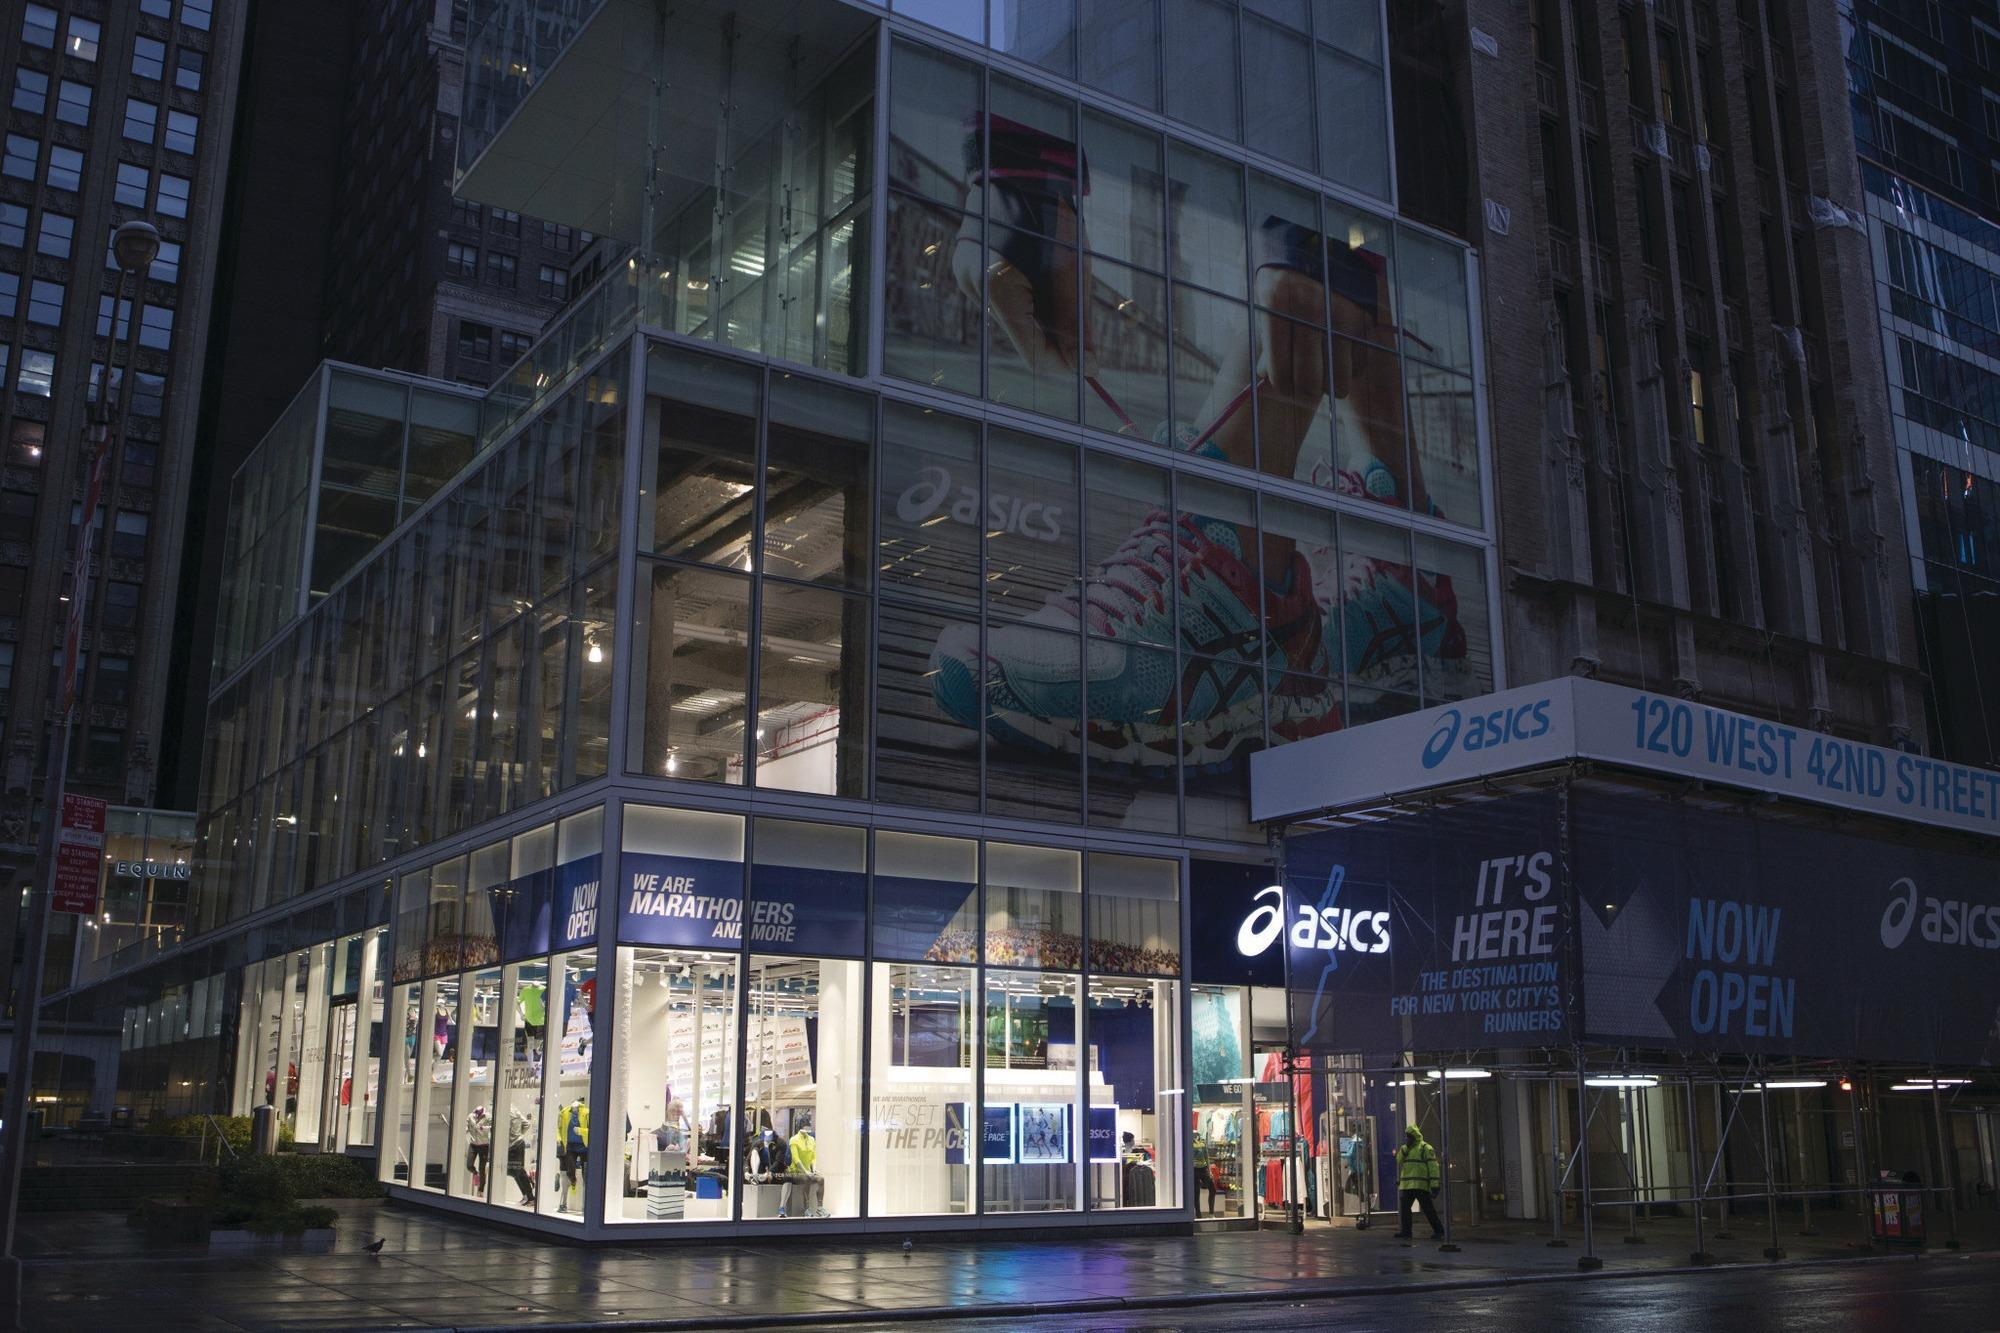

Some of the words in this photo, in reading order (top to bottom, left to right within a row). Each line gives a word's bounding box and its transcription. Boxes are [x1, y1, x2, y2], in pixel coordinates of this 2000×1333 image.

[951, 486, 1063, 542] asics
[1463, 699, 1550, 751] asics
[1632, 695, 1693, 758] 120
[1704, 709, 1797, 779] WEST
[1807, 737, 1886, 798] 42ND
[1896, 755, 2000, 821] STREET
[116, 862, 191, 879] EQUIN
[633, 873, 660, 892] WE
[661, 875, 696, 895] ARE
[1475, 851, 1553, 907] IT'S
[571, 880, 600, 913] NOW
[567, 908, 597, 941] OPEN
[711, 921, 743, 939] AND
[750, 924, 796, 943] MORE
[1291, 904, 1390, 954] asics
[1451, 905, 1558, 962] HERE
[1686, 897, 1782, 967] NOW
[1921, 896, 2000, 949] asics
[1420, 970, 1449, 992] THE
[1451, 961, 1558, 989] DESTINATION
[1391, 996, 1418, 1016] FOR
[1422, 993, 1456, 1014] NEW
[1460, 989, 1502, 1012] YORK
[1505, 985, 1559, 1009] CITY'S
[1690, 969, 1796, 1038] OPEN
[1484, 1009, 1562, 1033] RUNNERS
[1223, 1085, 1233, 1094] WE
[874, 1104, 901, 1126] WE
[905, 1104, 938, 1126] SET
[886, 1128, 917, 1149] THE
[923, 1128, 967, 1149] PACE
